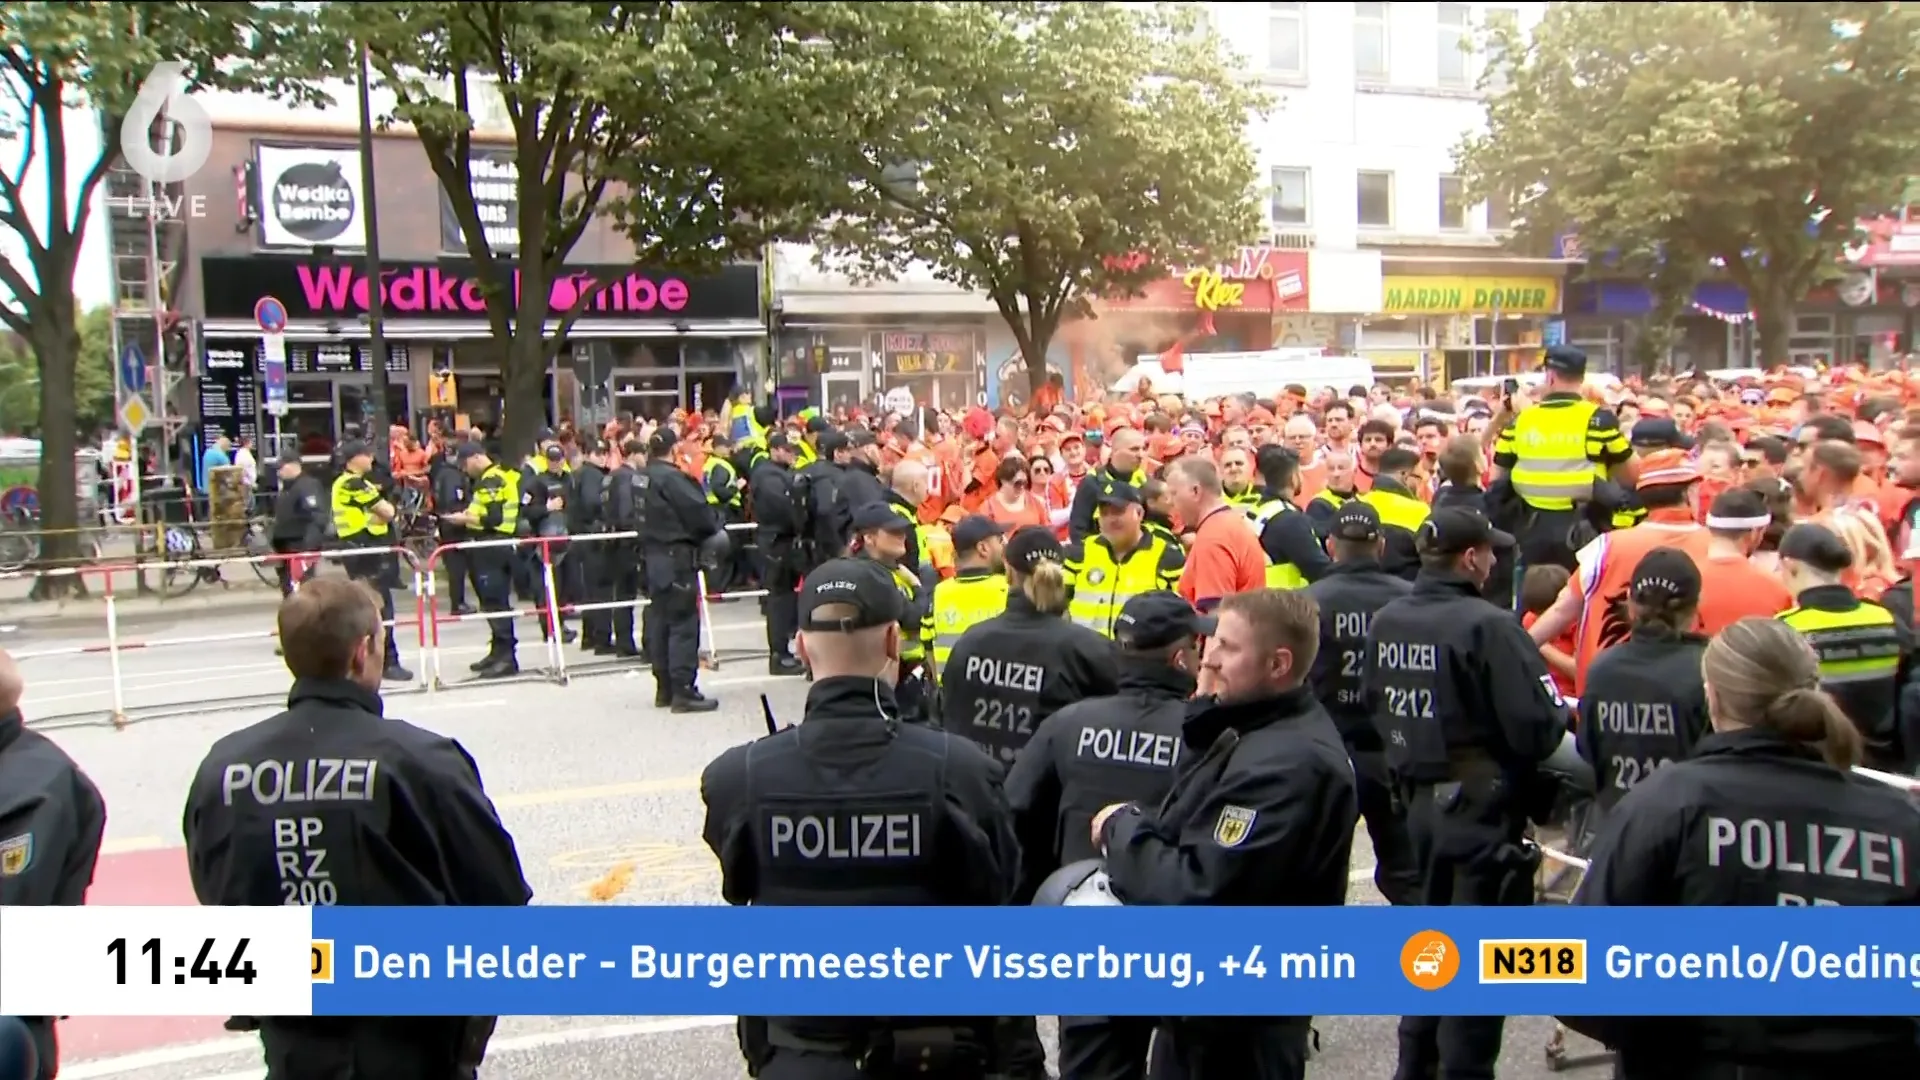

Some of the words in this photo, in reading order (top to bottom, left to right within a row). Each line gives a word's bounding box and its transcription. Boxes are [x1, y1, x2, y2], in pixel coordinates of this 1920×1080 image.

[1386, 288, 1461, 310] MARDIN
[816, 580, 857, 594] POLIZEI
[1378, 641, 1437, 671] POLIZEI
[966, 656, 1044, 692] POLIZEI
[972, 698, 1032, 735] 2212
[1597, 701, 1676, 736] POLIZEI
[1076, 726, 1181, 768] POLIZEI
[223, 758, 377, 806] POLIZEI
[274, 817, 323, 848] BP
[770, 813, 921, 858] POLIZEI
[276, 849, 330, 878] RZ
[1707, 815, 1906, 888] POLIZEI
[281, 880, 338, 905] 200
